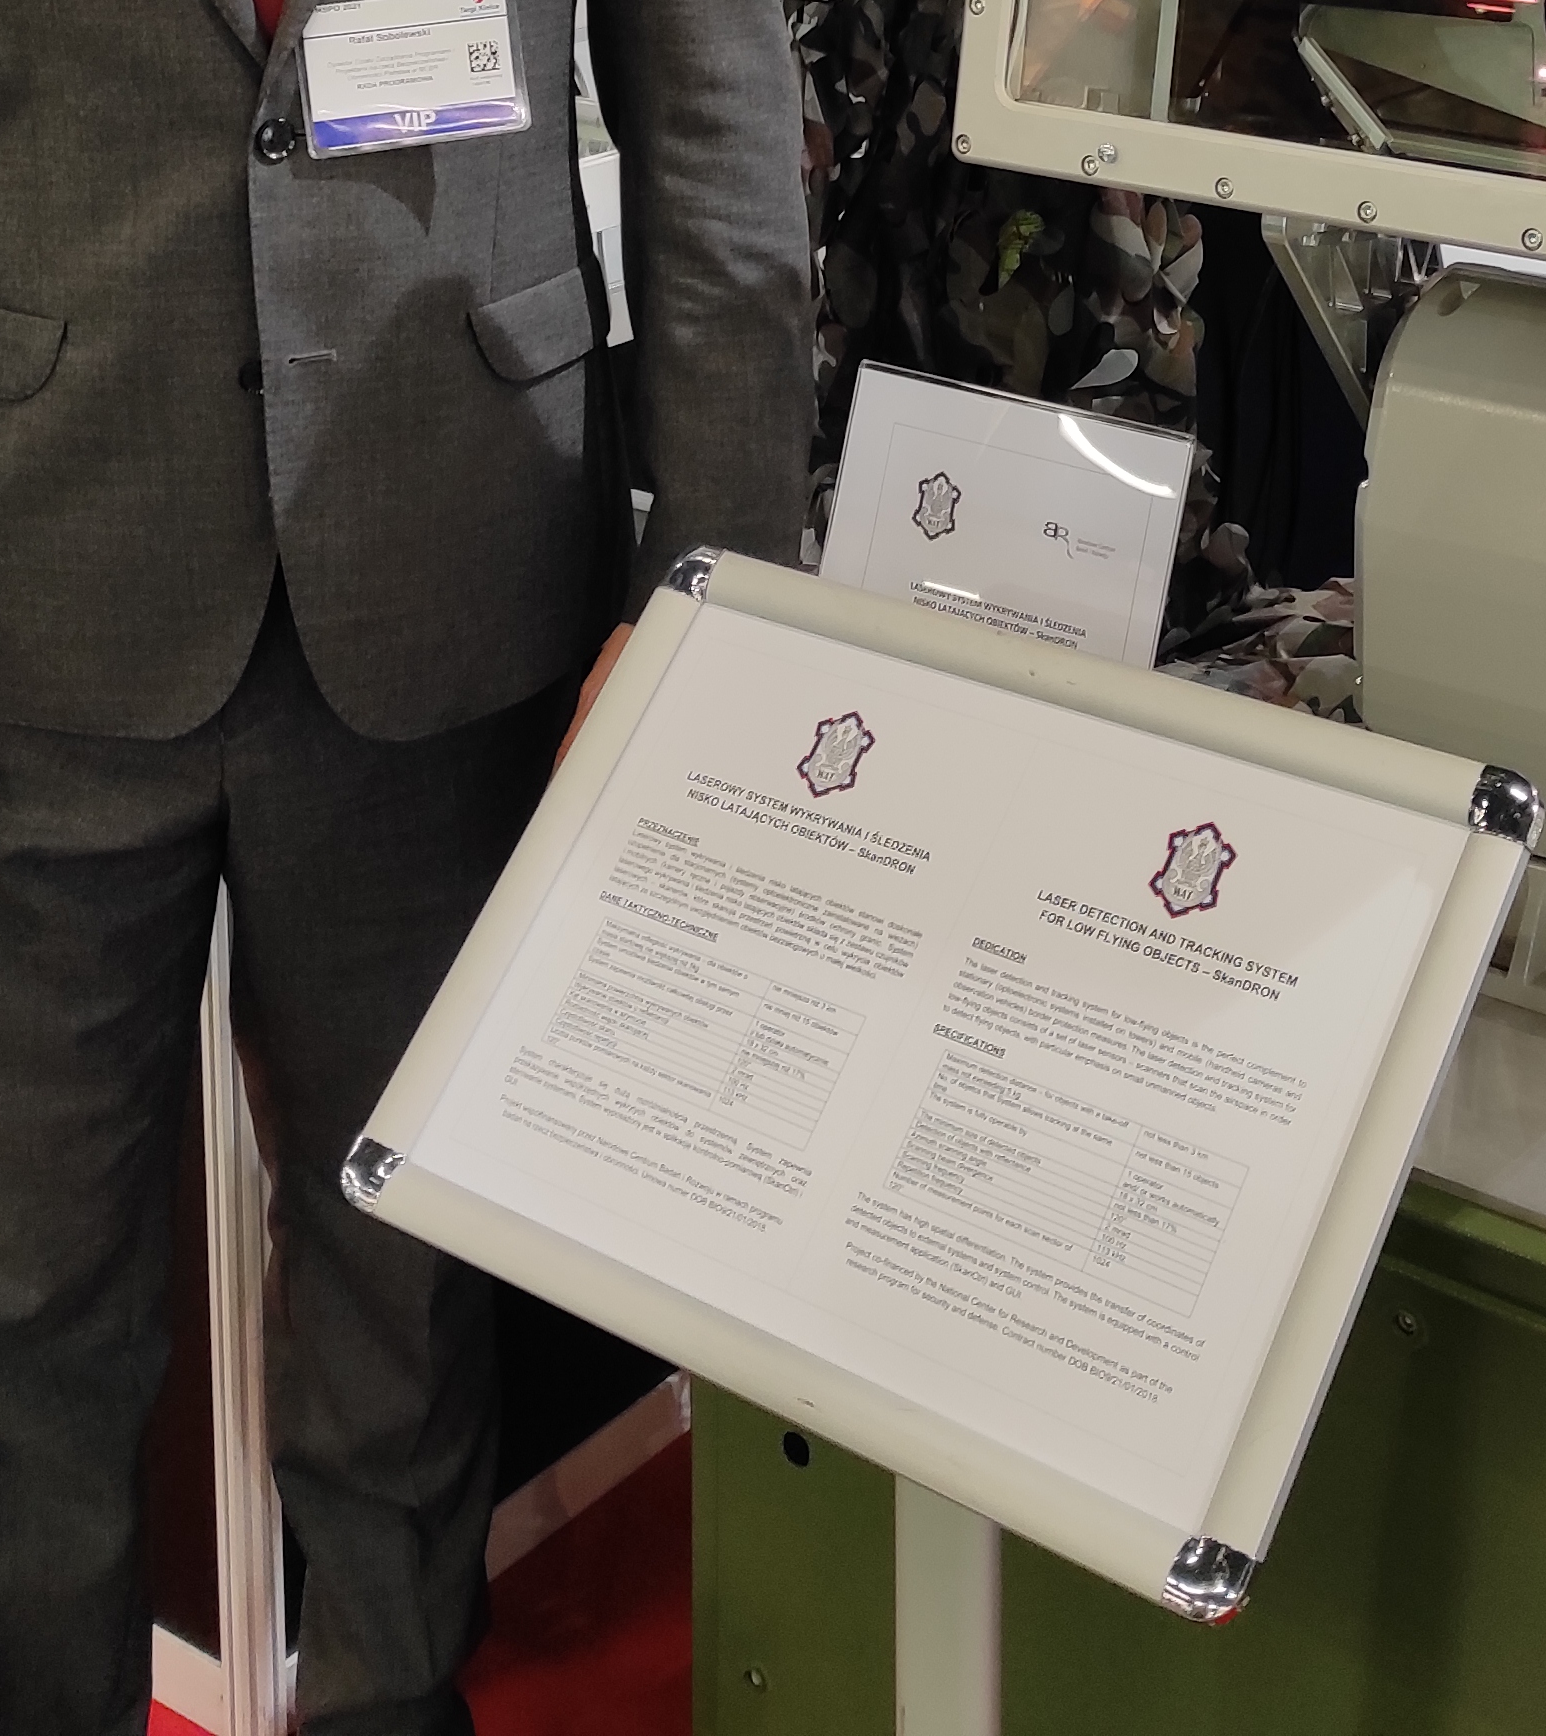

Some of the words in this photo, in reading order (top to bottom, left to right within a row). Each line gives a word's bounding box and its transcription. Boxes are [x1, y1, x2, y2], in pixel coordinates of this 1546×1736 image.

[392, 110, 437, 132] VIP
[686, 770, 745, 798] LASEROWY
[744, 790, 789, 812] SYSTEM
[788, 805, 863, 838] WYKRYWANIA
[863, 831, 870, 840] I
[869, 830, 933, 862] ŚLEDZENIA
[686, 788, 720, 807] NISKO
[718, 799, 790, 833] LATAJĄCYCH
[789, 821, 850, 852] OBIEKTÓW
[856, 846, 916, 875] SkanDRON
[972, 936, 1027, 963] DEDICATION
[1036, 889, 1078, 912] LASER
[1077, 903, 1148, 935] DETECTION
[1148, 927, 1177, 945] AND
[1178, 937, 1244, 968] TRACKING
[1244, 959, 1299, 987] SYSTEM
[1038, 909, 1066, 927] FOR
[1065, 918, 1096, 938] LOW
[1095, 928, 1142, 953] FLYING
[1141, 944, 1201, 974] OBJECTS
[1211, 968, 1281, 1001] SkanDRON
[933, 1022, 1006, 1056] SPECIFICATIONS
